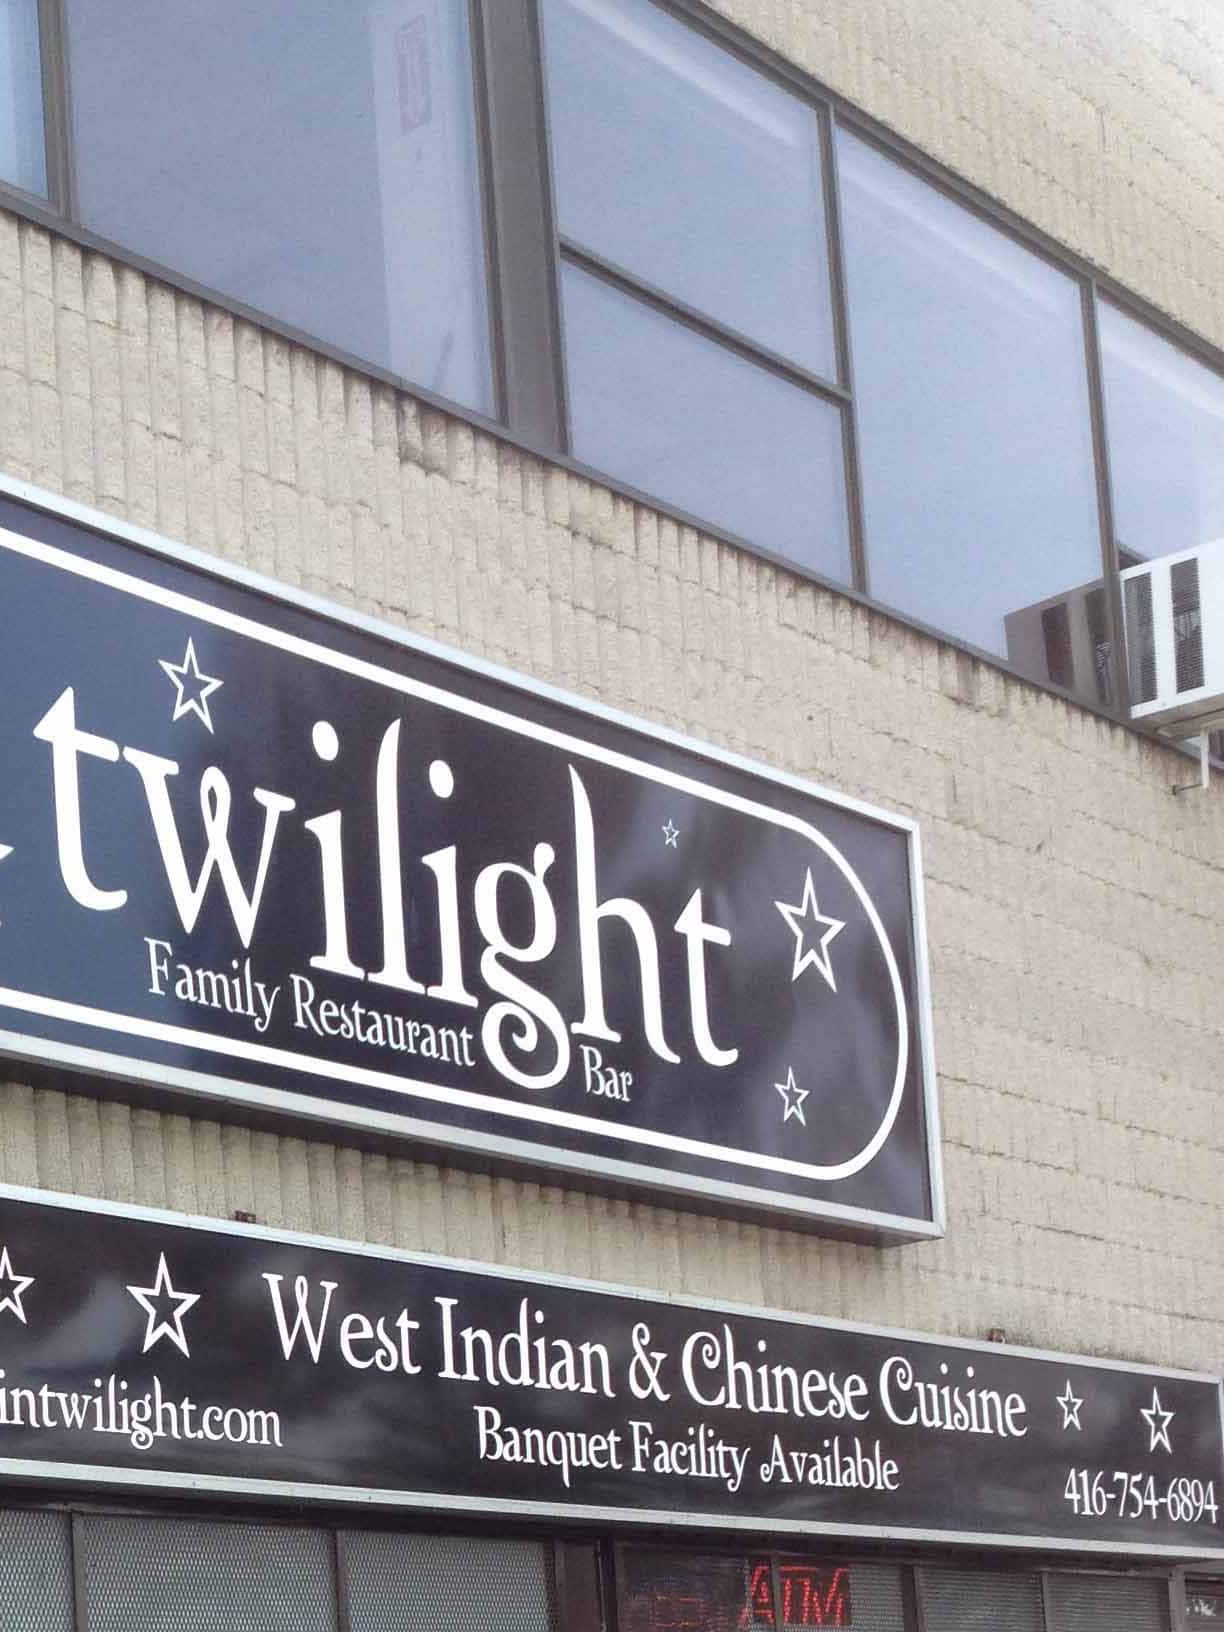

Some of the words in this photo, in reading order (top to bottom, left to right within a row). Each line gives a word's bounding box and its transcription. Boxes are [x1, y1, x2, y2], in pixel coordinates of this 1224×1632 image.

[33, 686, 740, 1091] twilight
[143, 937, 282, 1033] Family
[289, 972, 476, 1068] Restaurant
[580, 1045, 634, 1104] Bar
[262, 1272, 423, 1376] West
[434, 1296, 617, 1398] Indian
[628, 1322, 672, 1403] &
[681, 1323, 871, 1421] Chinese
[878, 1355, 1029, 1438] Cuisine
[473, 1405, 624, 1488] Banquet
[627, 1420, 752, 1492] Facility
[759, 1434, 901, 1491] Available
[1063, 1467, 1220, 1524] 416-754-6894
[736, 1565, 850, 1630] ATM
